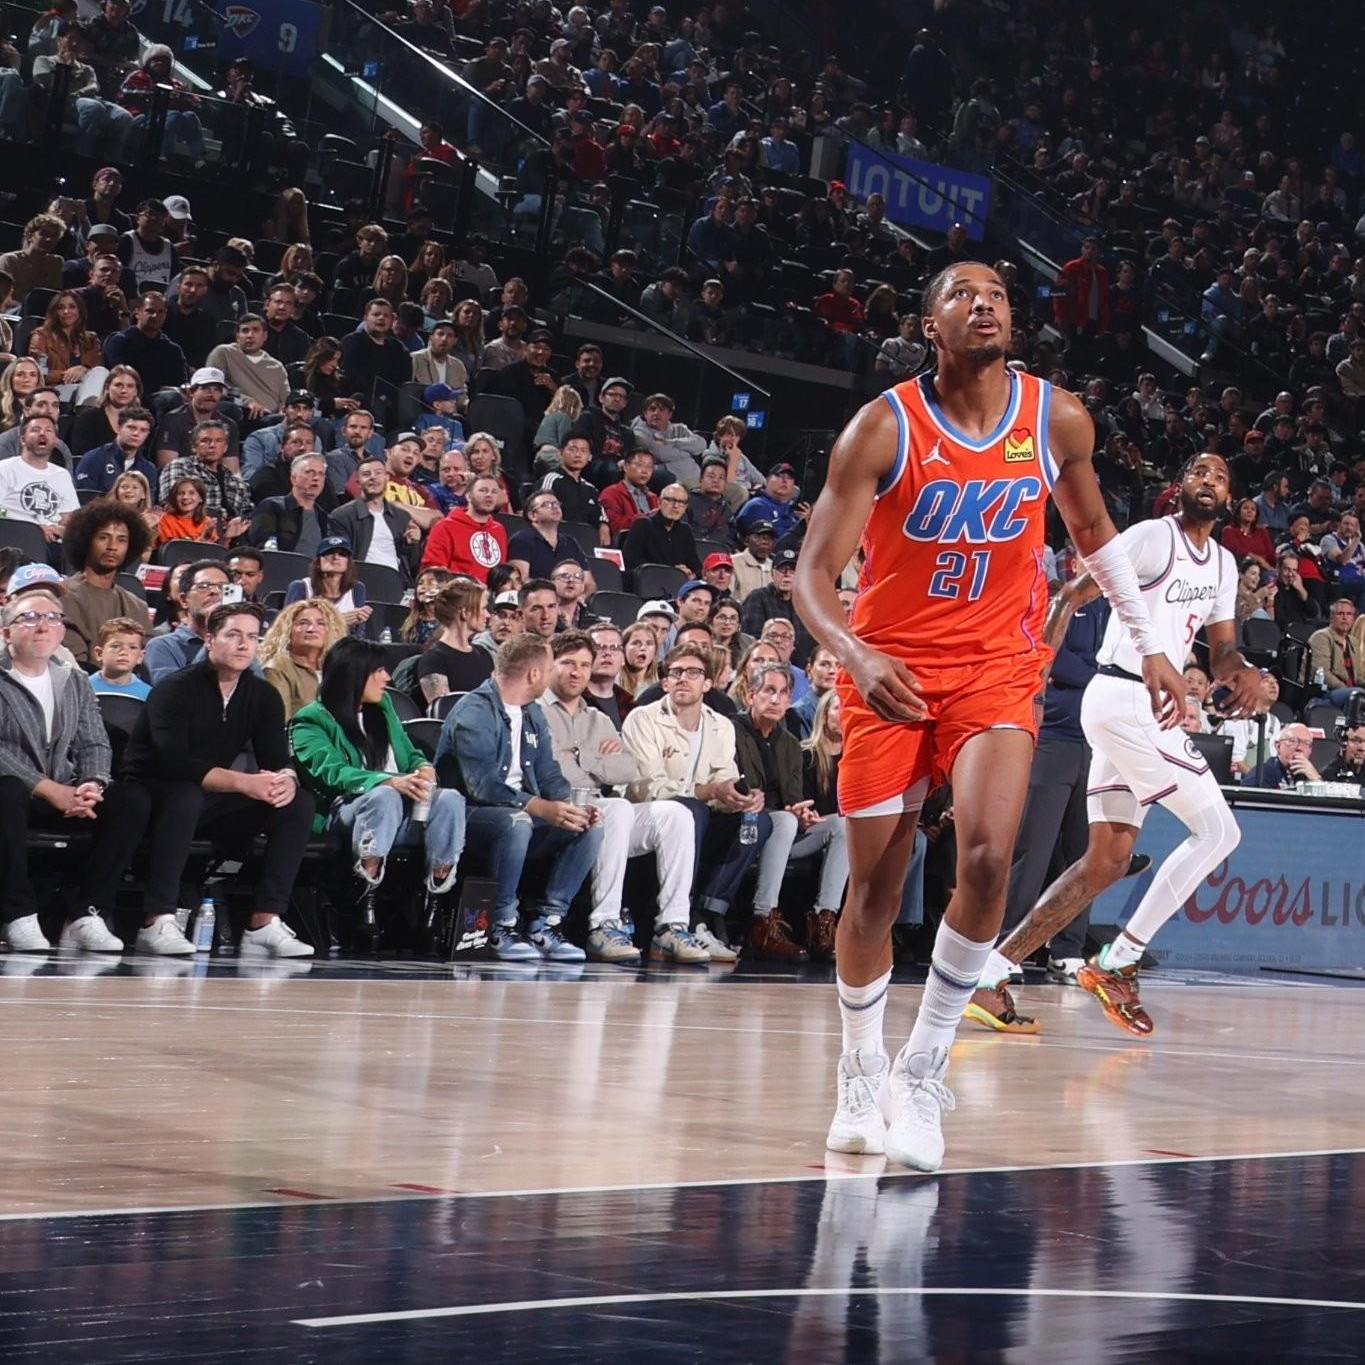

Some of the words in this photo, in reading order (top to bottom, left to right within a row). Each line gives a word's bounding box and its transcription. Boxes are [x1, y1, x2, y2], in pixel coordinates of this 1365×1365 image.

[278, 23, 298, 54] 9
[850, 158, 985, 225] INTUIT
[903, 476, 1041, 545] OKC
[928, 550, 992, 602] 21
[1164, 578, 1217, 614] Clippers
[1185, 613, 1203, 640] 5
[1184, 858, 1312, 926] Coors
